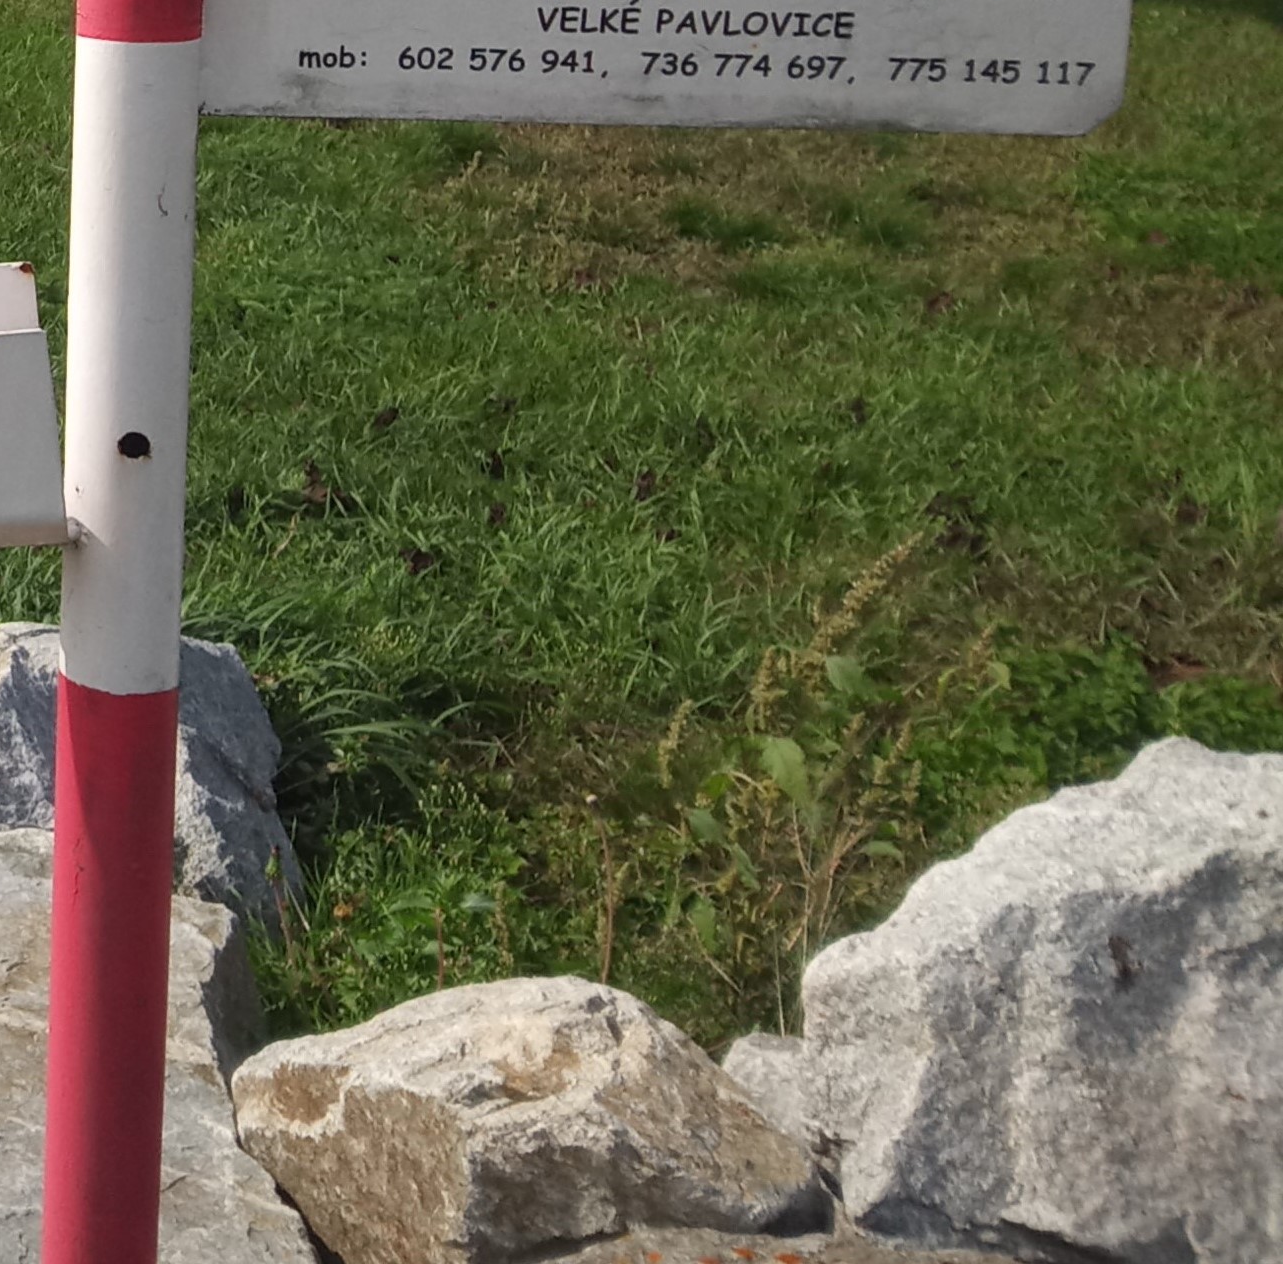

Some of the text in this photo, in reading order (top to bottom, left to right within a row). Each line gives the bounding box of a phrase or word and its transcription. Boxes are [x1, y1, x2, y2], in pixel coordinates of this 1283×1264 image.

[655, 9, 856, 39] PAVLOVICE
[298, 45, 1097, 87] mob: 602 576 941, 736 774 697, 775 145 117
